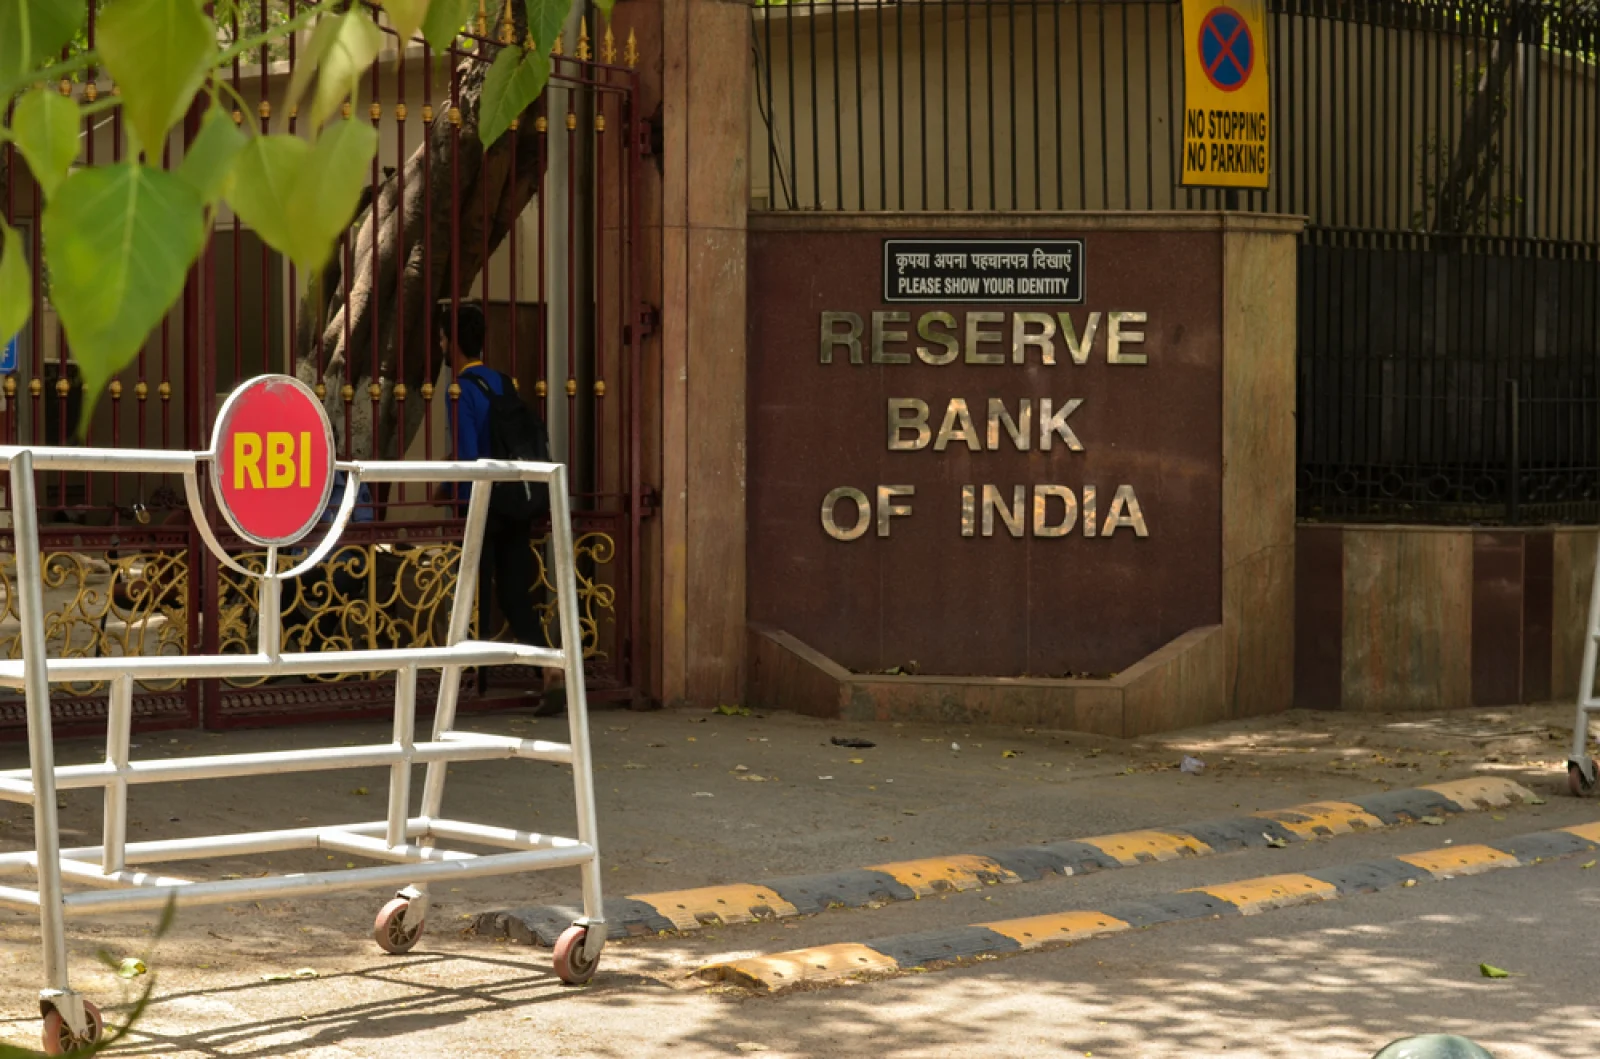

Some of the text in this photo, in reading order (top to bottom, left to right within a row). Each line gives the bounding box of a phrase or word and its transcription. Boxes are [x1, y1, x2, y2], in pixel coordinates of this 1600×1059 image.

[1187, 109, 1266, 141] NO STOPPING
[1186, 142, 1265, 174] NO PARKING
[896, 248, 1072, 274] कृपया अपना पहचानपत्र दिखाएं
[898, 277, 1070, 294] PLEASE SHOW YOUR IDENTITY
[819, 310, 1149, 366] RESERVE
[886, 398, 1085, 451] BANK
[233, 431, 311, 490] RBI
[820, 484, 1149, 541] OF INDIA
